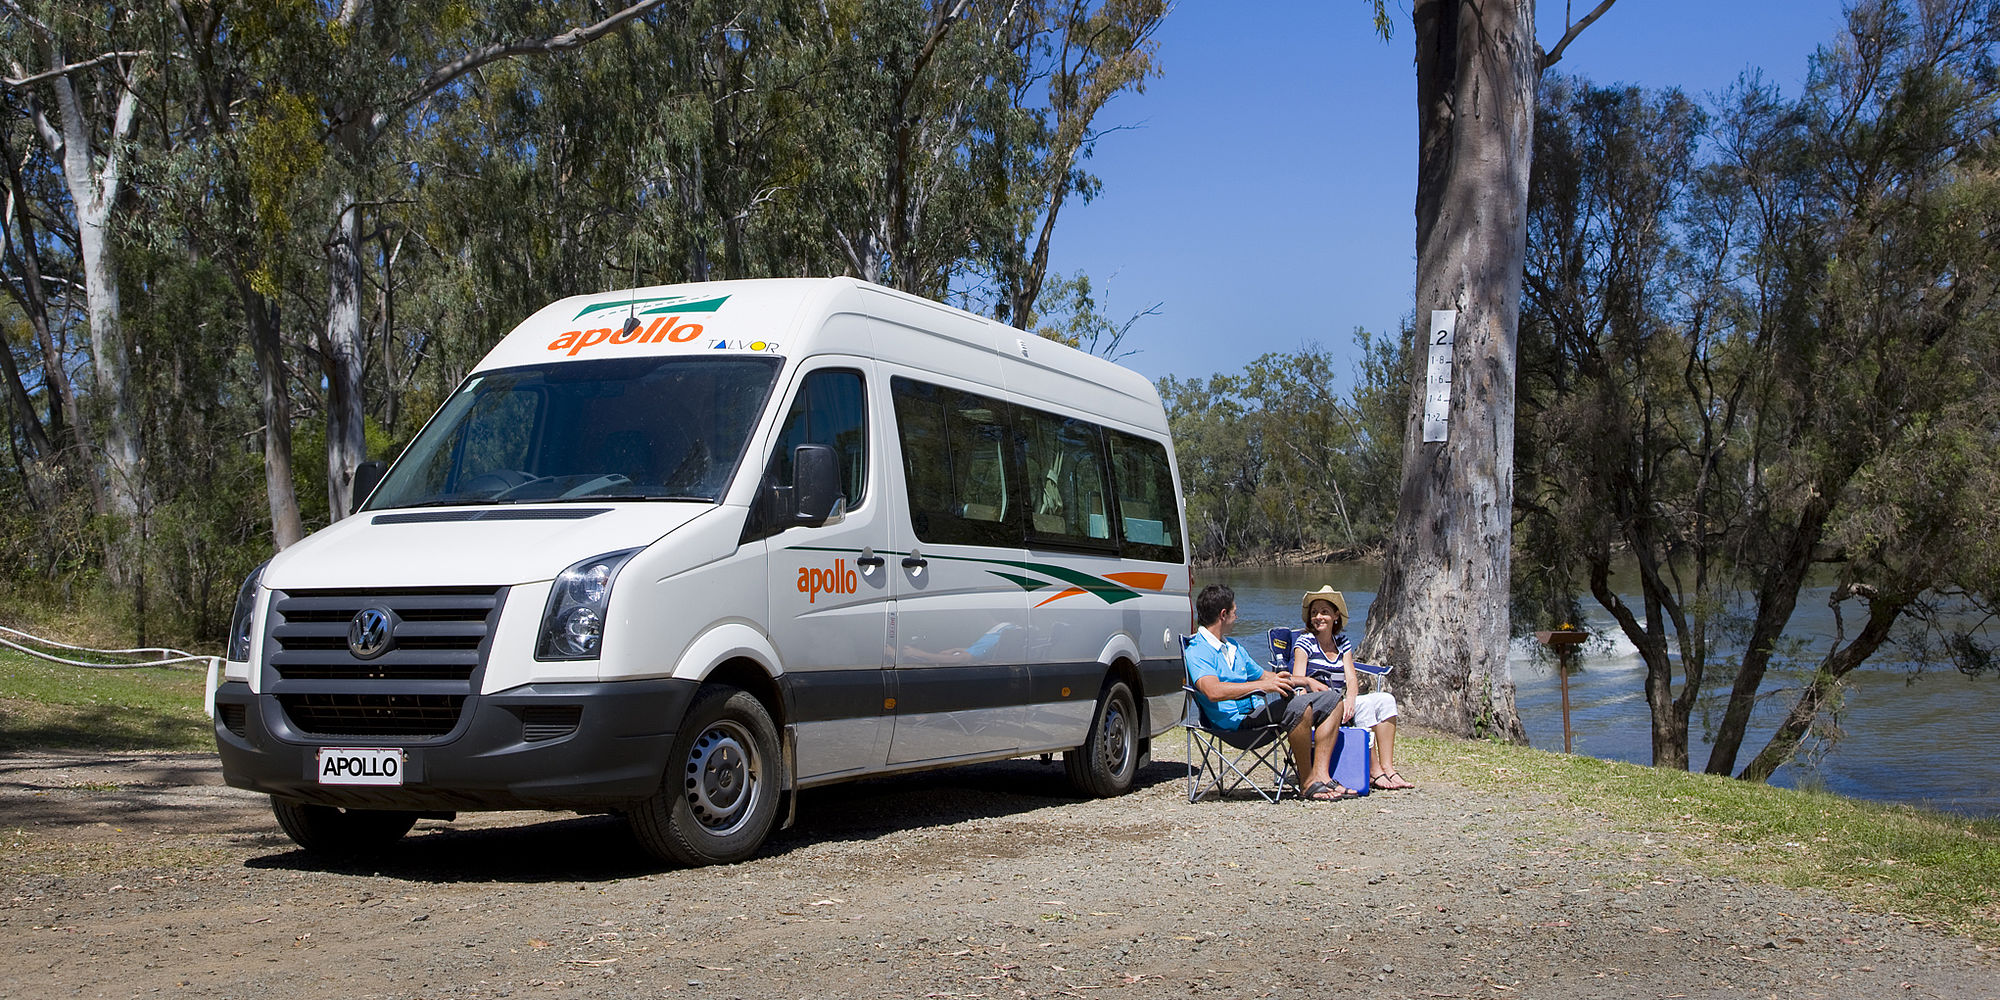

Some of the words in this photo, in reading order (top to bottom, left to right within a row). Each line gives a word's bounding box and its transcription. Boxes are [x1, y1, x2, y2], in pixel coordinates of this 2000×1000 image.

[547, 316, 704, 356] apollo
[708, 338, 779, 353] TALVOR
[1436, 330, 1448, 345] 2
[797, 558, 857, 603] apollo
[323, 757, 397, 776] APOLLO
